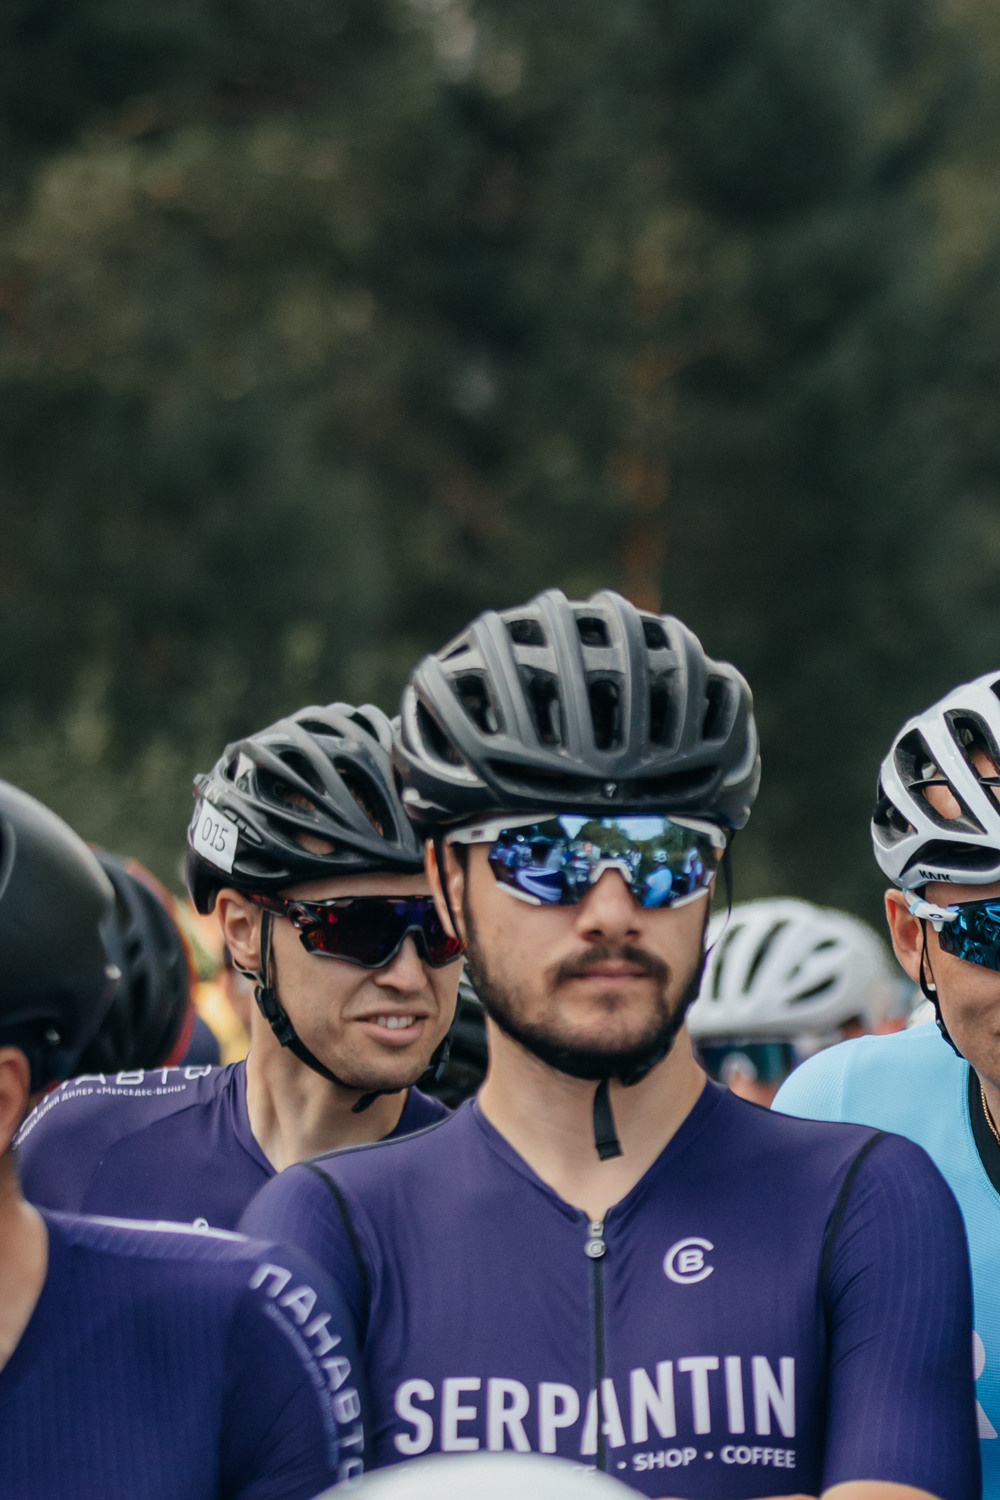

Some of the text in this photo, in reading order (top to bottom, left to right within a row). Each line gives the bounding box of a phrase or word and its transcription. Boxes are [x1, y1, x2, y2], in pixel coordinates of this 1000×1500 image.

[394, 1355, 797, 1456] SERPANTIN
[632, 1445, 798, 1472] SHOP COFFEE
